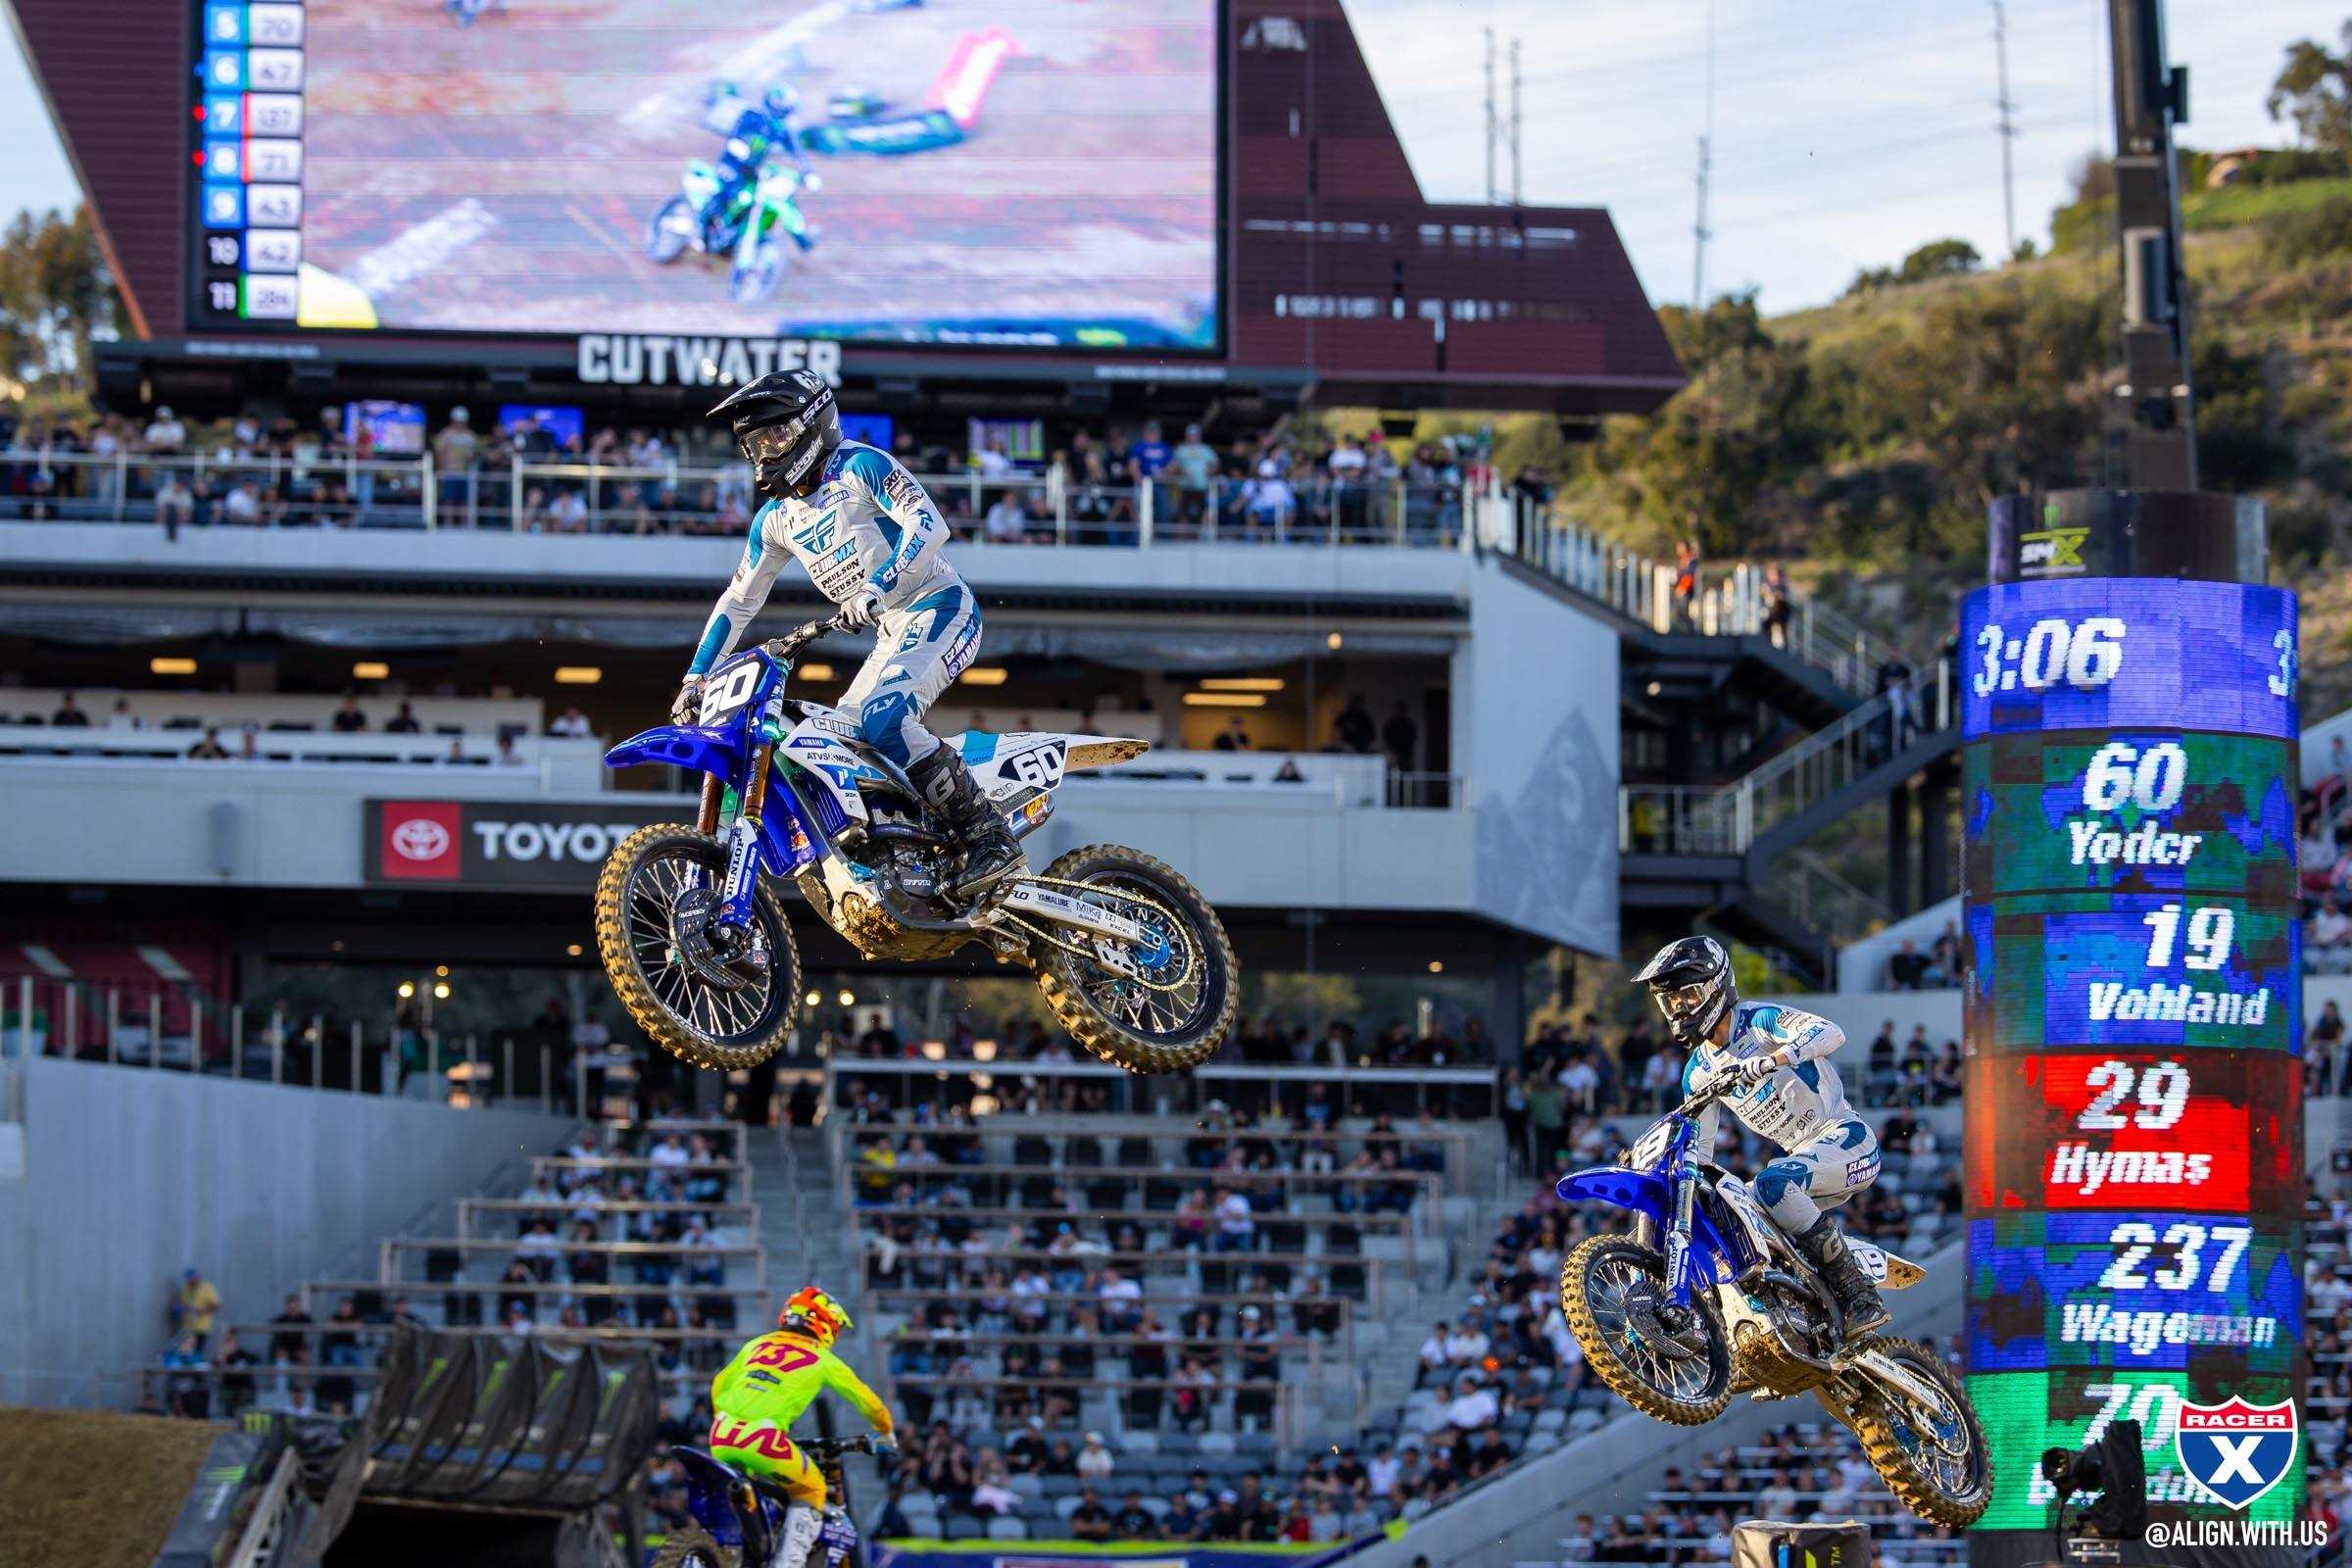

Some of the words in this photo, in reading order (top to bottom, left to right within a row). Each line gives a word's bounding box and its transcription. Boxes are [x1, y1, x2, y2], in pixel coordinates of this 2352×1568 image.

[215, 11, 238, 40] 5
[214, 56, 239, 84] 6
[213, 101, 237, 127] 7
[212, 191, 236, 219] 9
[208, 236, 239, 266] 10
[208, 282, 237, 310] 11
[577, 335, 843, 389] CUTWATER
[808, 535, 858, 580] CLUBMX
[821, 558, 860, 589] PAULSON
[829, 568, 865, 599] STUSSY
[1973, 617, 2127, 697] 3:06
[699, 662, 760, 727] 60
[863, 695, 897, 723] FLY
[798, 738, 825, 747] YAMAHA
[1012, 744, 1064, 787] 60
[2082, 742, 2188, 812] 60
[472, 821, 637, 861] TOYOT
[2069, 821, 2203, 864] Yoder
[726, 837, 745, 897] DUNLOP
[1037, 893, 1070, 908] YAMALUBE
[2143, 905, 2234, 970] 19
[2088, 982, 2270, 1025] Vohland
[1749, 1094, 1781, 1124] PAULSON
[1757, 1101, 1787, 1131] STUSSY
[2077, 1060, 2191, 1130] 29
[2051, 1141, 2213, 1195] Hymas
[1668, 1243, 1679, 1287] DUNLOP
[2097, 1221, 2254, 1293] 237
[2082, 1384, 2182, 1451] 70
